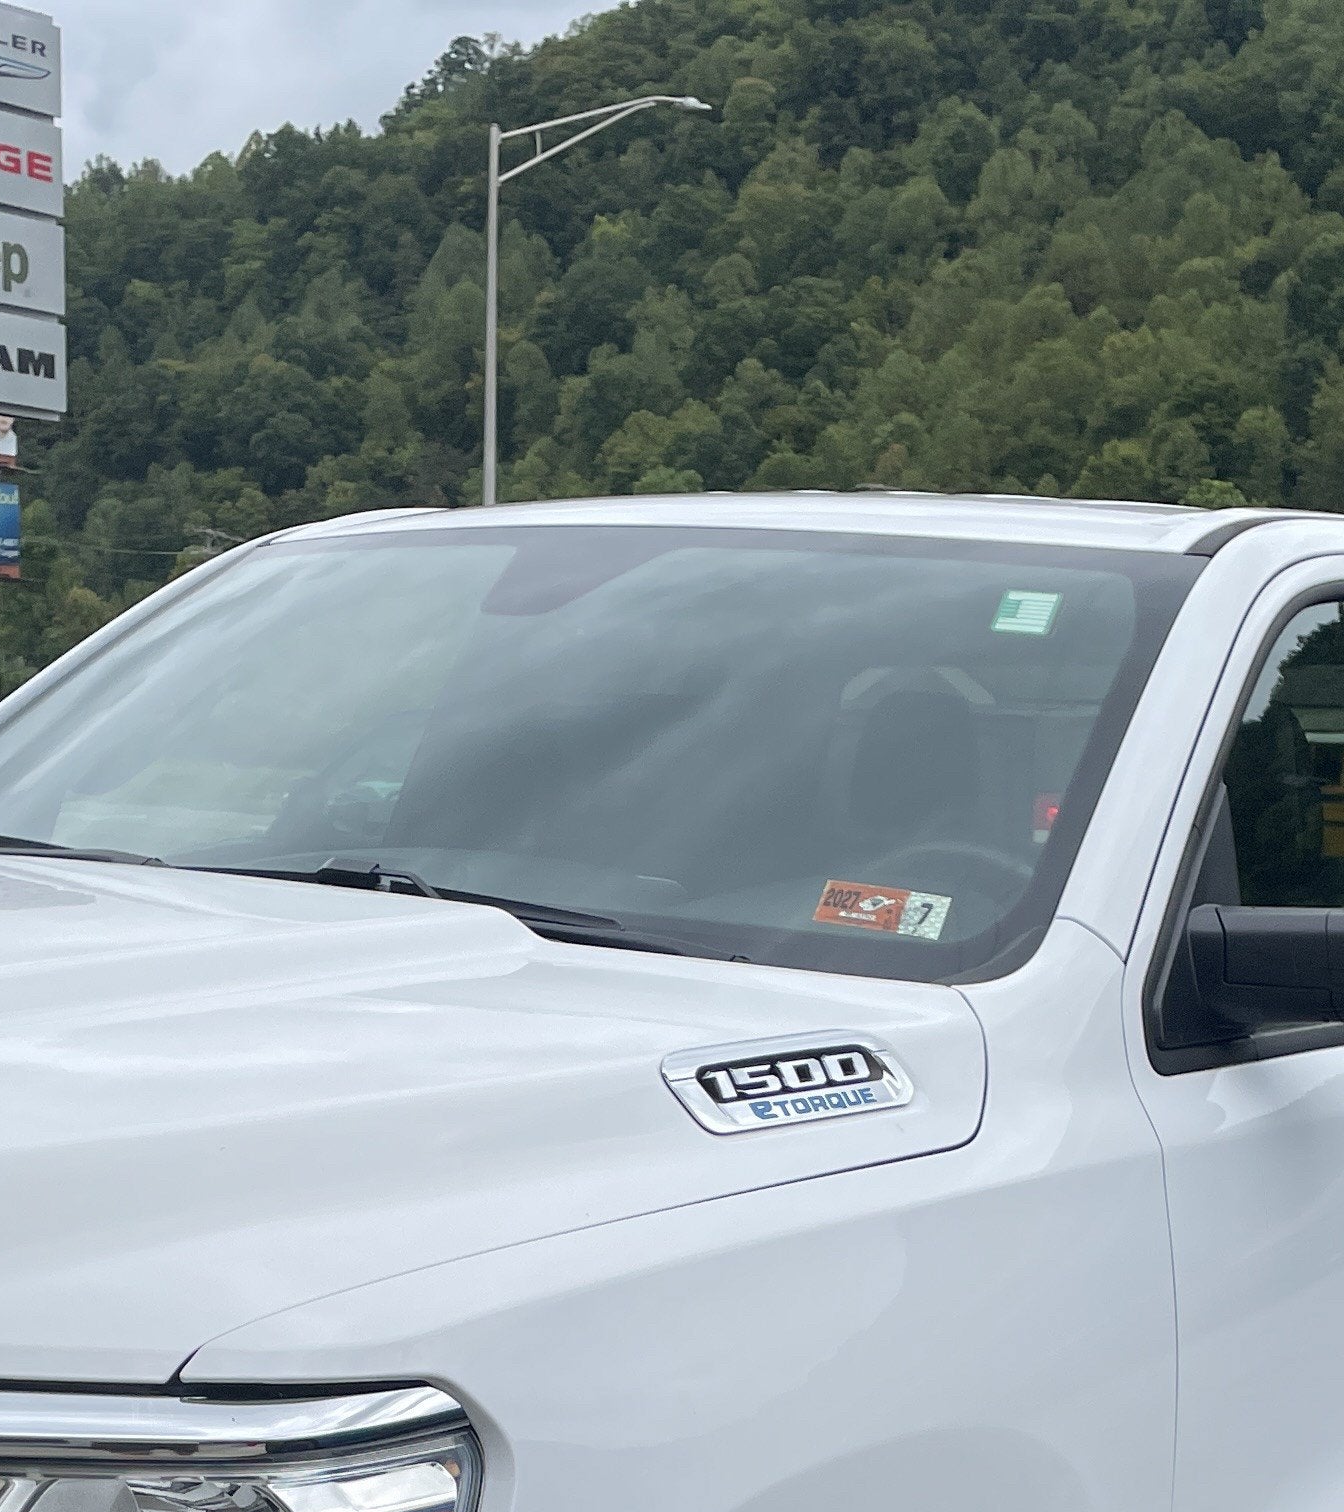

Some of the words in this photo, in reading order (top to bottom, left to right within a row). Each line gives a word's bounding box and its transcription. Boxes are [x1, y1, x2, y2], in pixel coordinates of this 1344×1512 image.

[823, 888, 862, 909] 2027
[916, 902, 934, 925] 7
[703, 1050, 871, 1099] 1500
